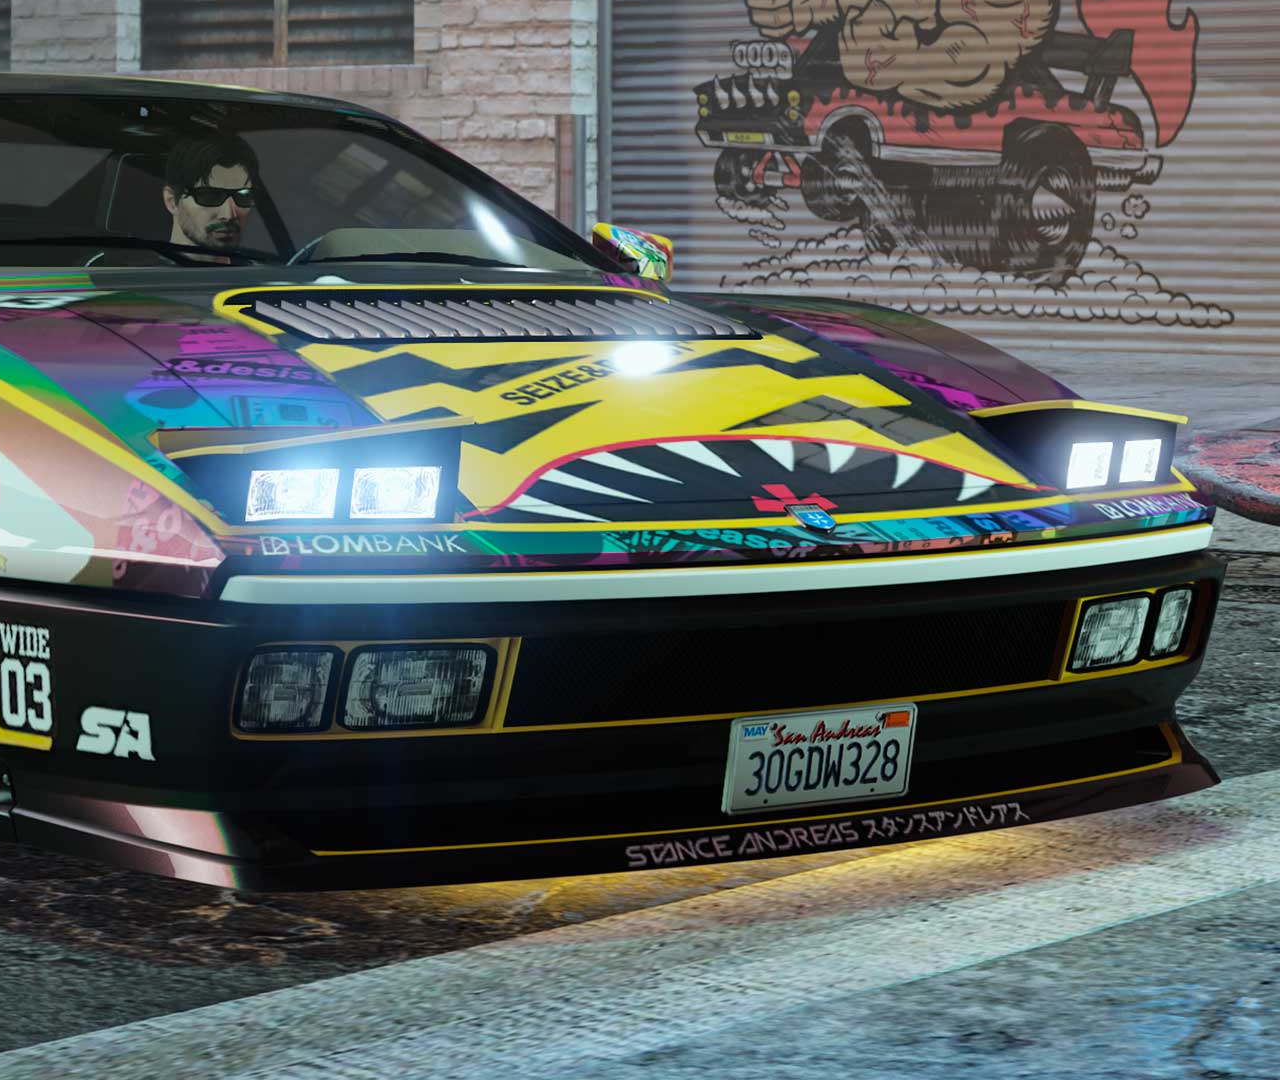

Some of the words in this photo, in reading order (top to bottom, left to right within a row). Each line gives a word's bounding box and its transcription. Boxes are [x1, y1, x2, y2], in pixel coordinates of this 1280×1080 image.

[295, 534, 467, 556] LOMBANK
[0, 657, 53, 732] 03
[76, 706, 156, 761] SA
[743, 725, 768, 738] MAY
[773, 723, 807, 747] San
[810, 719, 882, 744] Andreas
[625, 834, 733, 868] STANCE
[736, 820, 860, 856] ANDREAS
